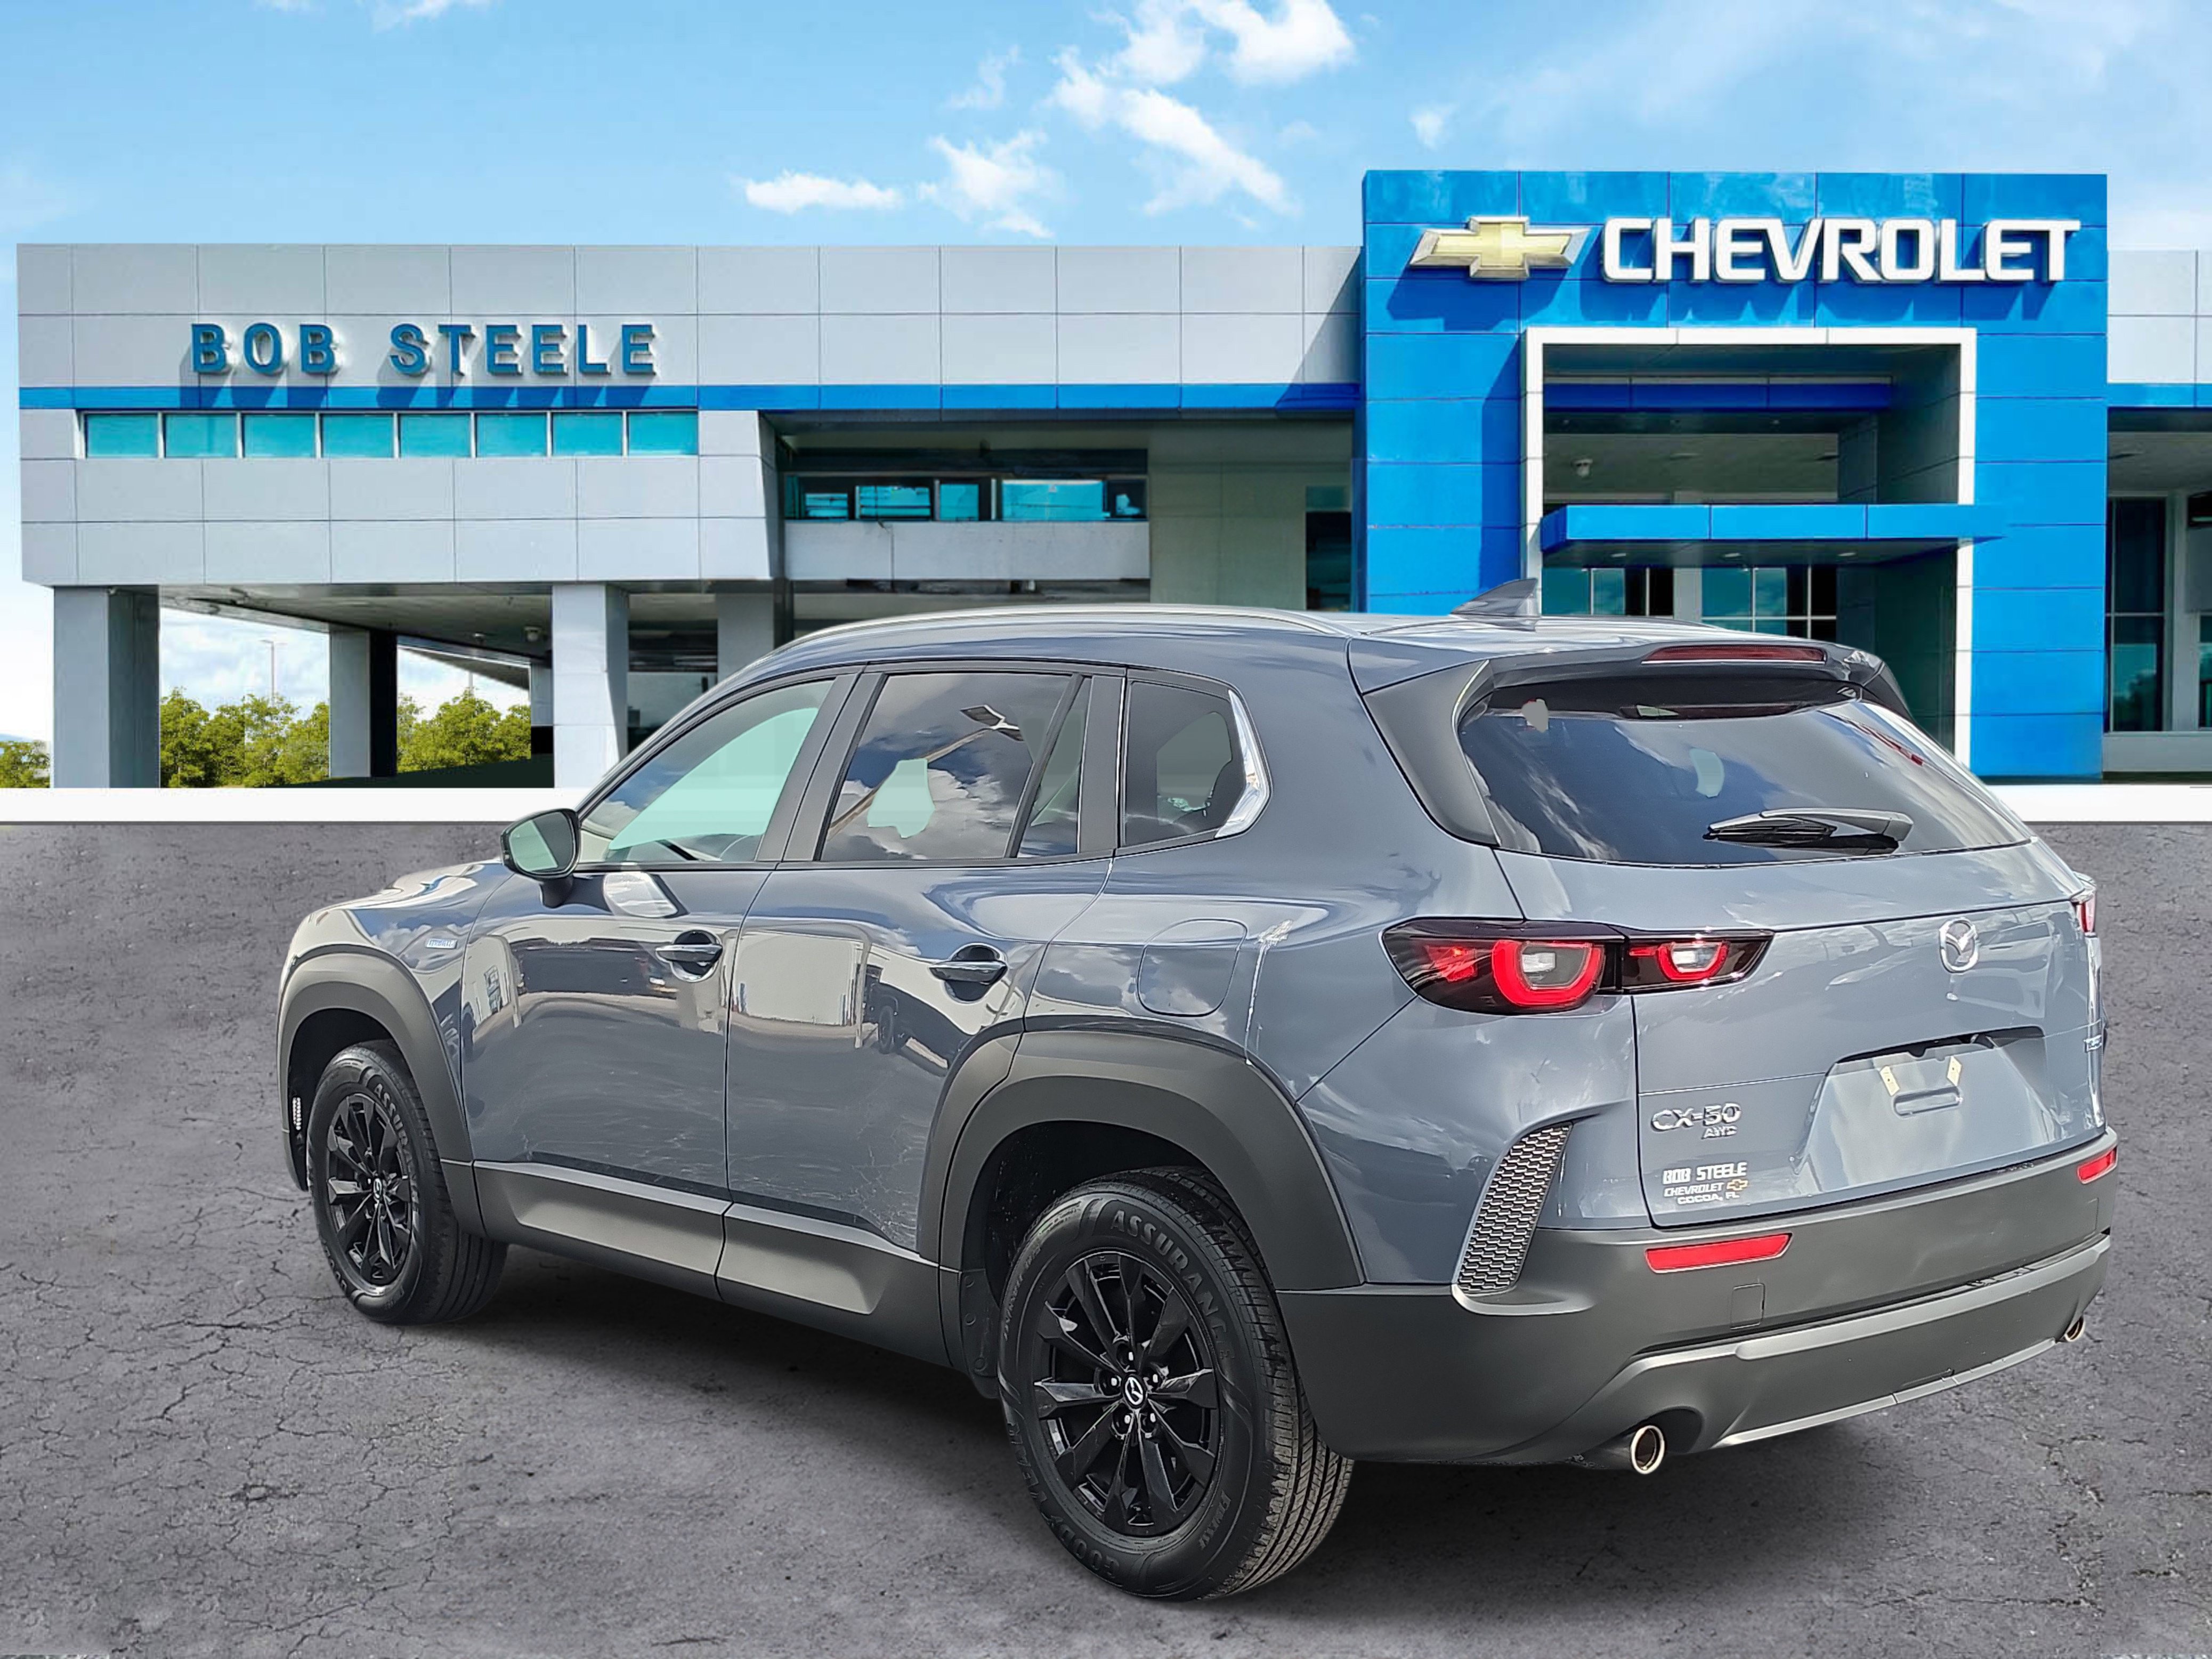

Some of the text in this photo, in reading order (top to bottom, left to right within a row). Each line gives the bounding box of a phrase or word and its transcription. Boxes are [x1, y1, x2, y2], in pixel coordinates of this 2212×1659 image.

[1601, 217, 2080, 282] CHEVROLET
[191, 323, 657, 375] BOB STEELE
[1652, 1103, 1741, 1130] CX-50
[1663, 1162, 1747, 1184] BOB STEELE
[1664, 1182, 1725, 1197] CHEVROLET
[1111, 1210, 1235, 1359] ASSURANCE
